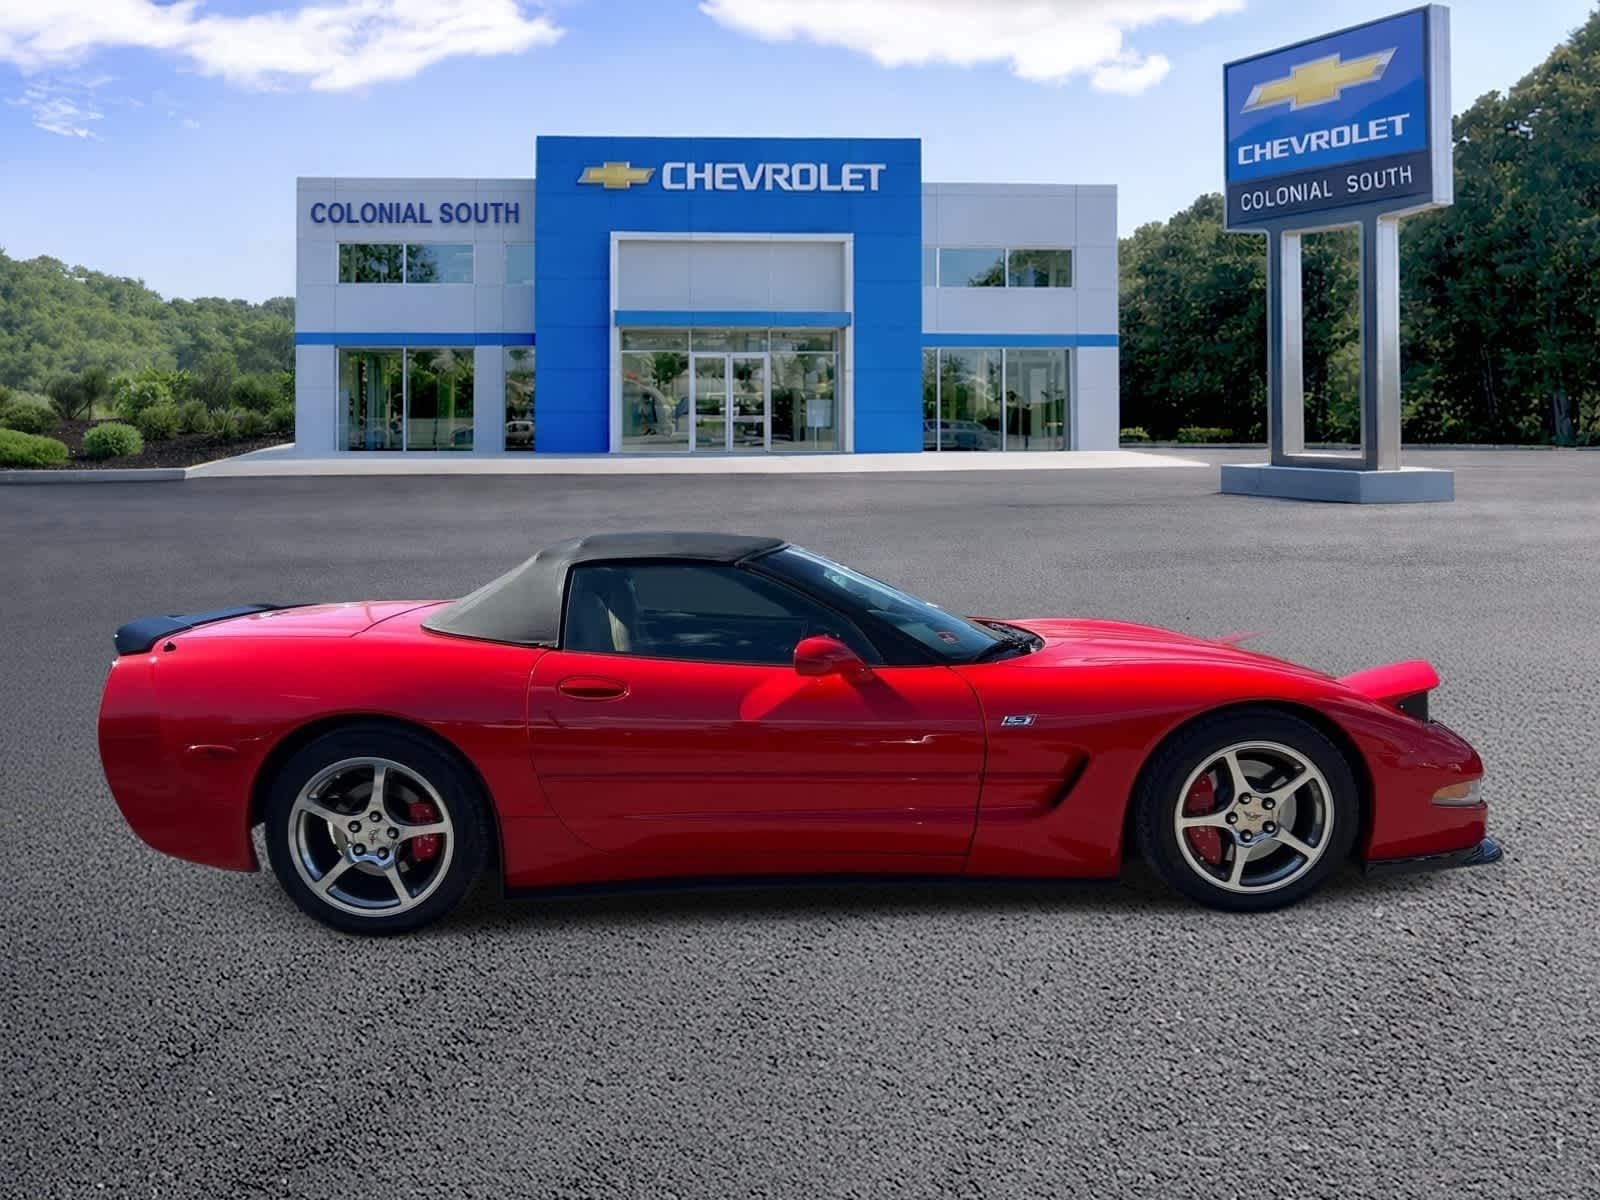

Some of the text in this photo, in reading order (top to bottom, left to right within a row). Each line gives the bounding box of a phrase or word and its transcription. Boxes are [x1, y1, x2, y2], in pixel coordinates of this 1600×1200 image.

[1237, 113, 1410, 165] CHEVROLET
[662, 162, 886, 191] CHEVROLET
[1240, 165, 1413, 211] COLONIAL SOUTH
[310, 202, 520, 224] COLONIAL SOUTH
